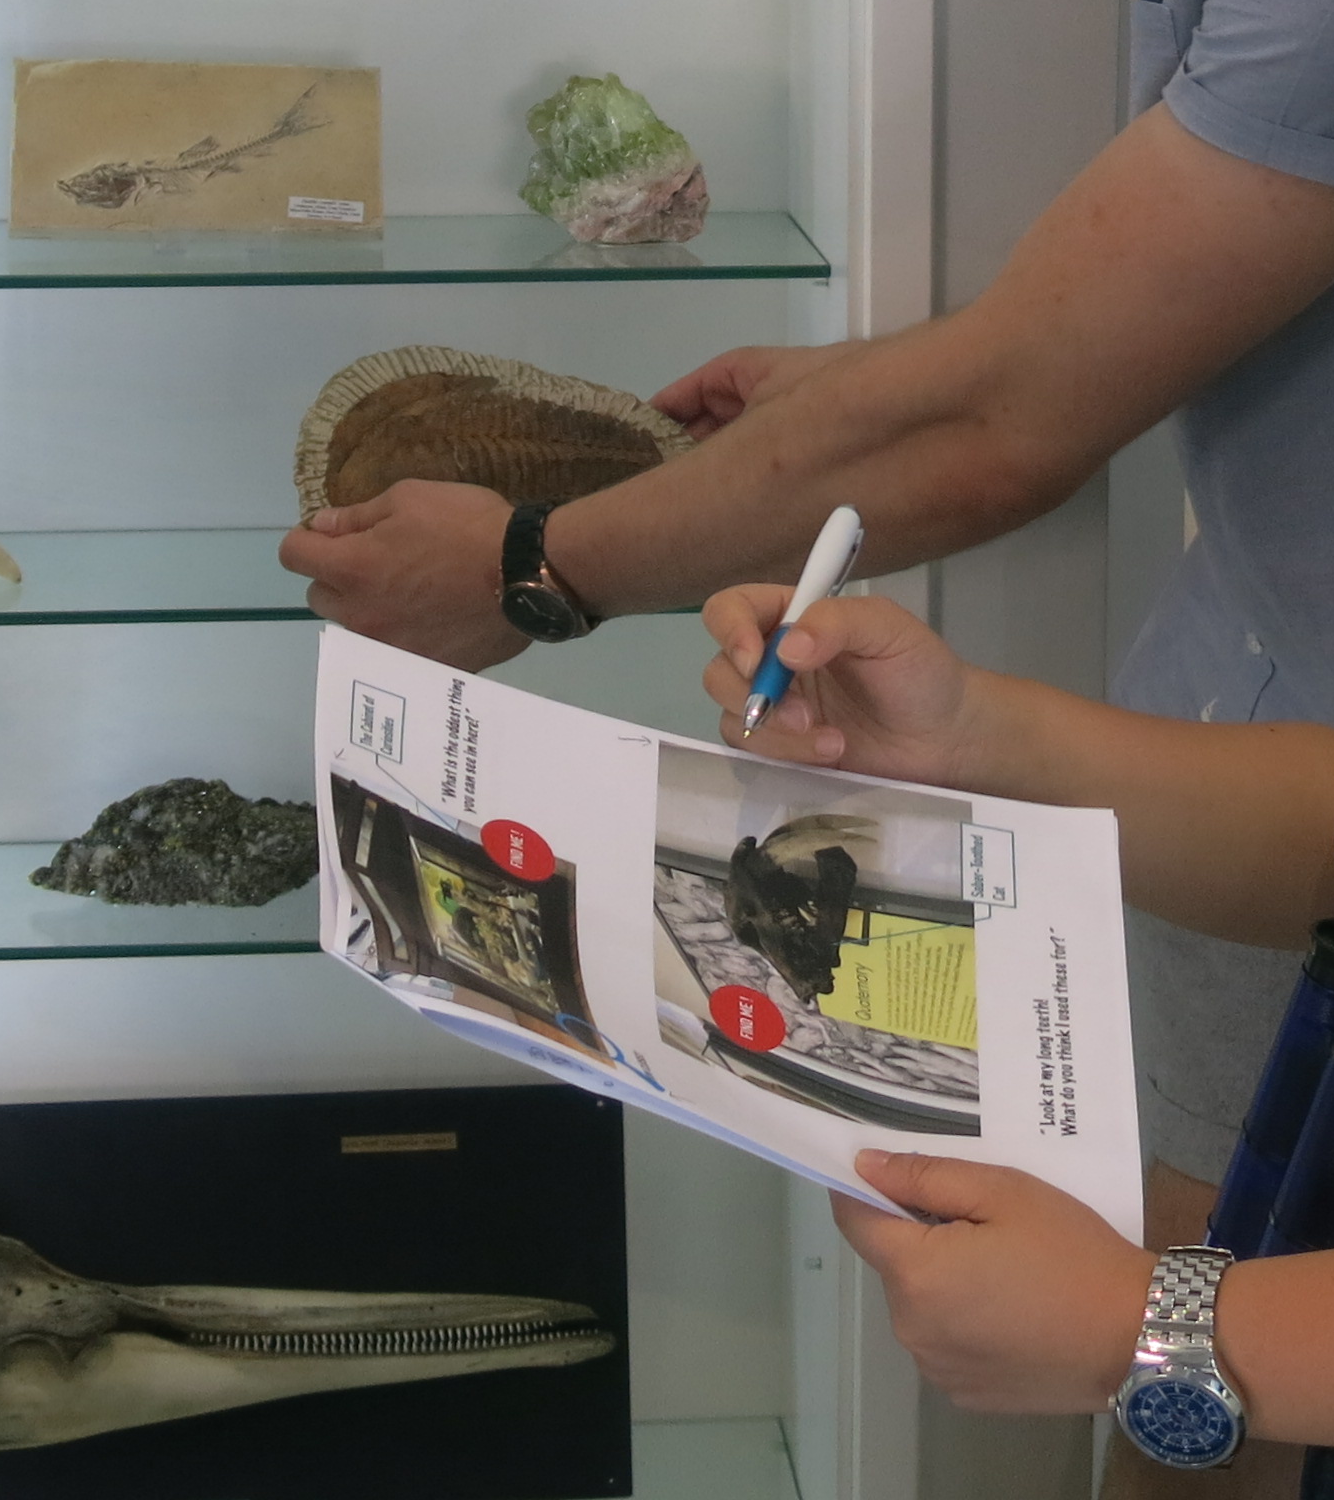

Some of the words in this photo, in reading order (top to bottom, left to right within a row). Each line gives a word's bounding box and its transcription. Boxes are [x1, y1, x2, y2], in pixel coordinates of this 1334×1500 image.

[447, 678, 465, 705] thing
[446, 705, 461, 739] oddest
[443, 739, 459, 758] the
[463, 744, 478, 756] in
[443, 759, 457, 769] is
[465, 757, 477, 775] see
[464, 774, 476, 795] can
[463, 794, 477, 814] you
[509, 848, 524, 870] FIND
[970, 833, 984, 898] Saber-Toothed
[992, 886, 1006, 901] Cat
[1051, 962, 1069, 994] these
[1033, 998, 1051, 1033] teeth!
[1053, 995, 1070, 1021] used
[739, 1017, 754, 1041] FIND
[1035, 1035, 1054, 1060] long
[1054, 1029, 1073, 1061] think
[1040, 1061, 1056, 1081] my
[1061, 1063, 1077, 1084] you
[1039, 1082, 1054, 1097] at
[1059, 1086, 1075, 1101] do
[1060, 1101, 1078, 1137] What
